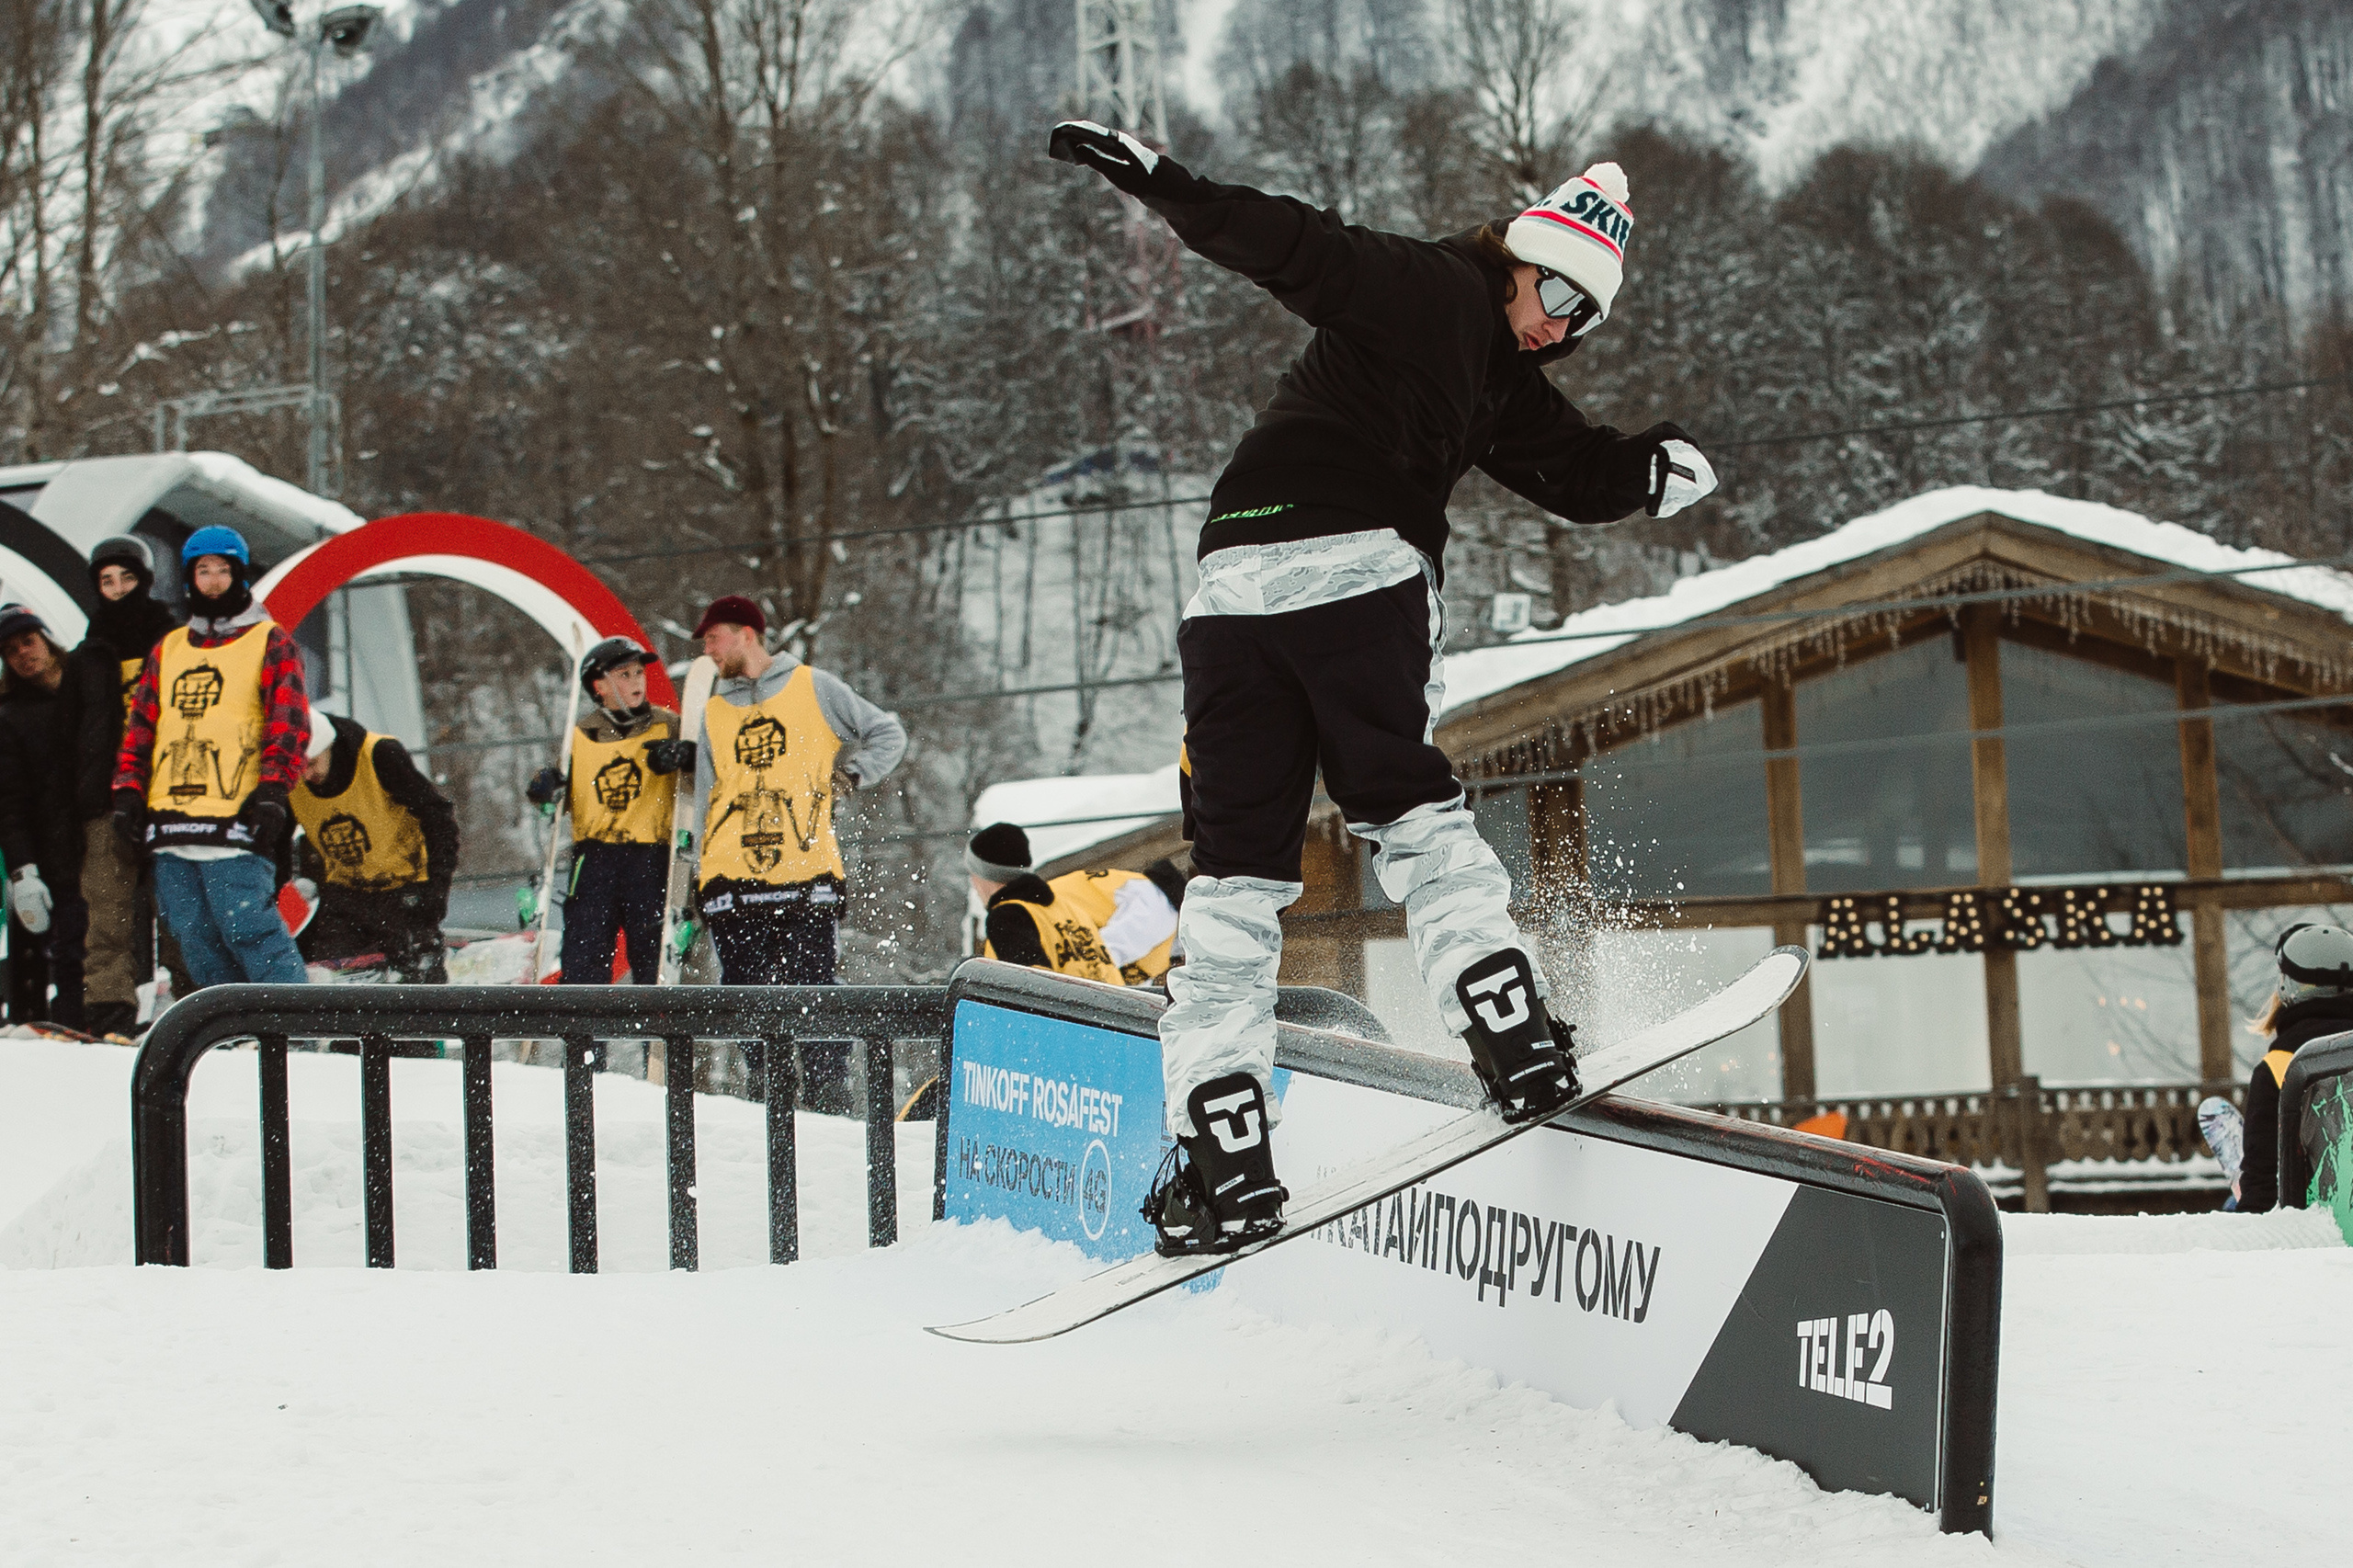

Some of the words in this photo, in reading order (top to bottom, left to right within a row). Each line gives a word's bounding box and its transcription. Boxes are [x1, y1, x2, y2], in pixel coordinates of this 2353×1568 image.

[1817, 883, 2184, 959] ALASKA
[963, 1061, 1030, 1115] TINKOFF
[1032, 1076, 1123, 1138] ROSAFEST
[959, 1136, 981, 1183] НА
[984, 1144, 1077, 1207] СКОРОСТИ
[1083, 1168, 1108, 1213] 4G
[1797, 1308, 1894, 1411] TELE2
